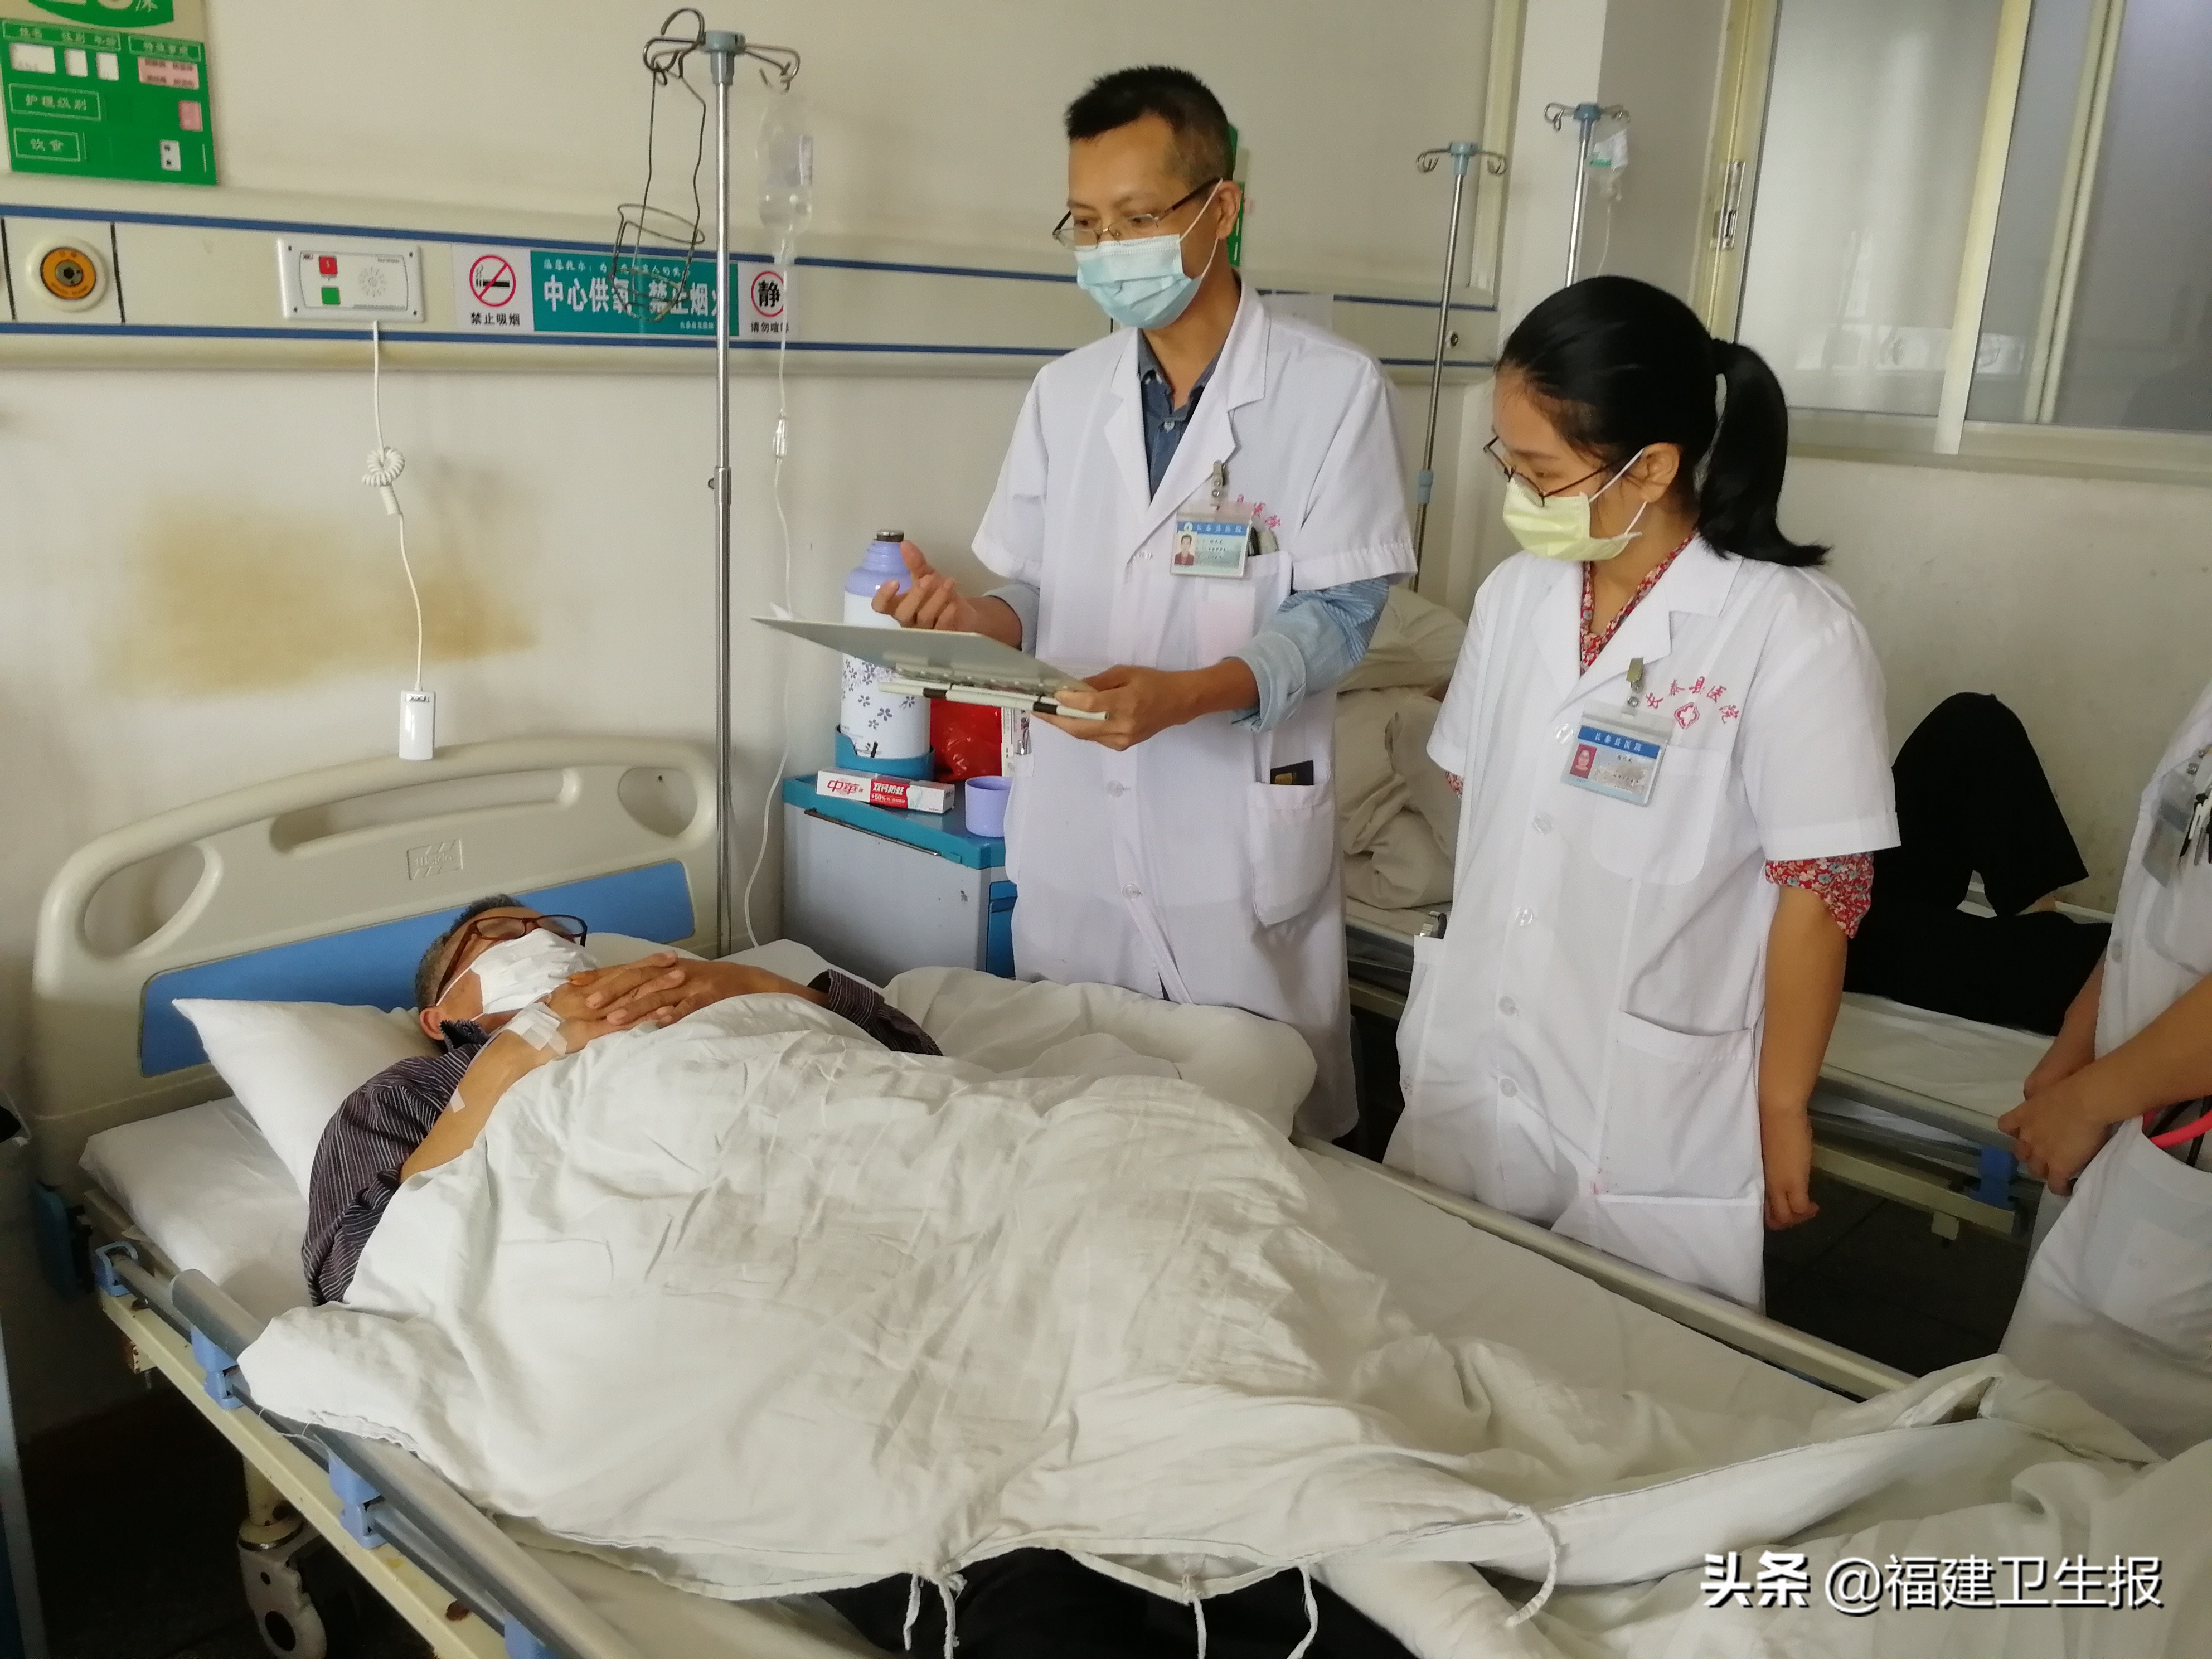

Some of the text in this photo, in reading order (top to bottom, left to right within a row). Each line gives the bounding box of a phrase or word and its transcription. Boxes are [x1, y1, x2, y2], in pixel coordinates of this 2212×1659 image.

[544, 274, 632, 314] 中心供氧
[758, 280, 780, 308] 静
[470, 312, 520, 326] 禁止吸烟
